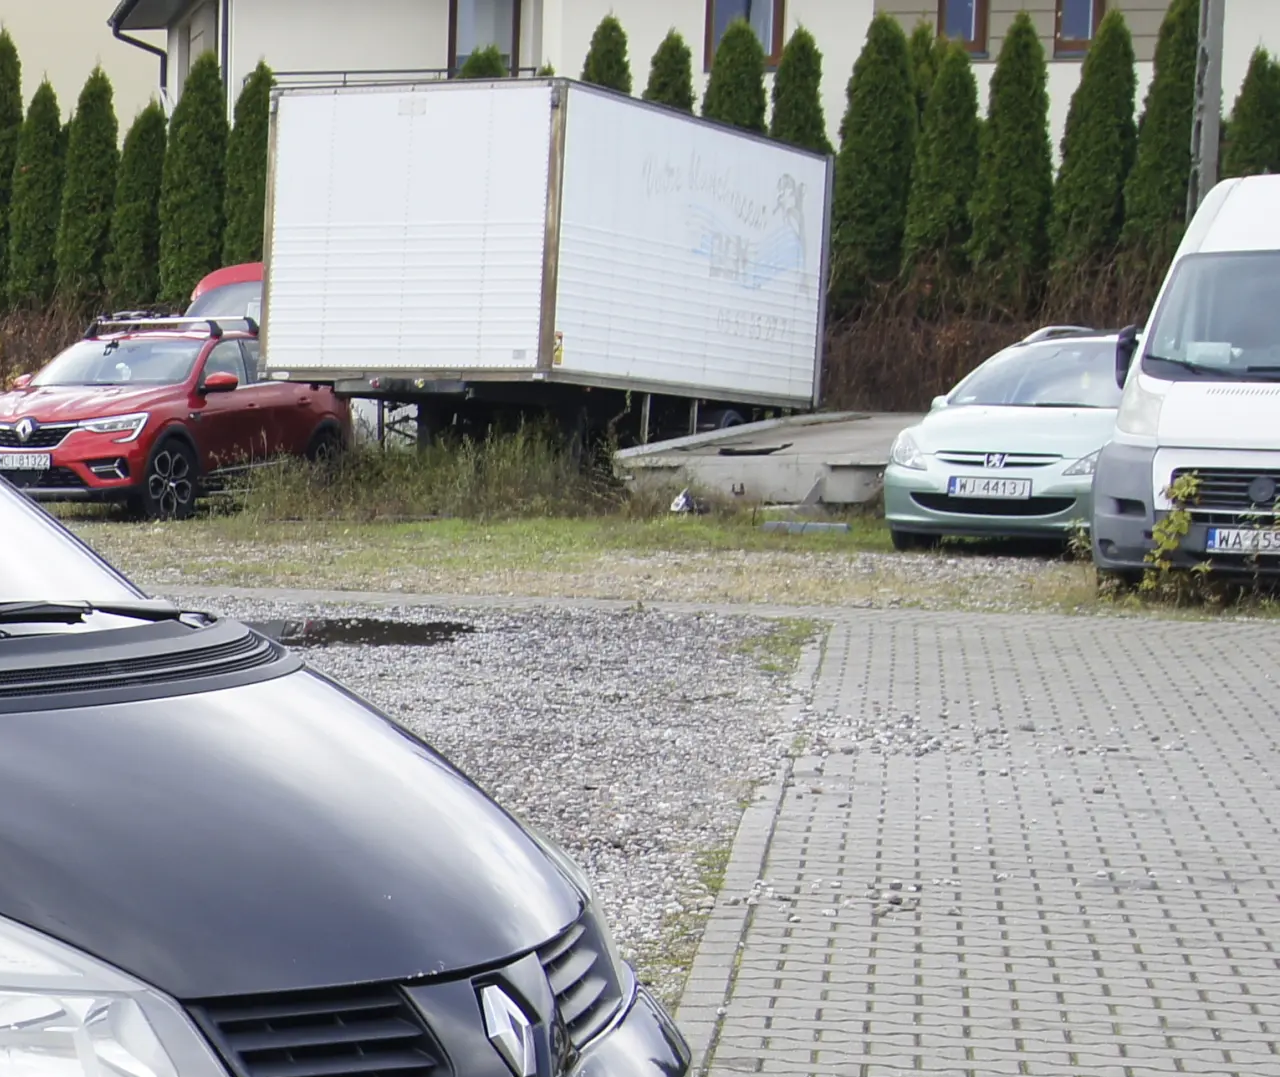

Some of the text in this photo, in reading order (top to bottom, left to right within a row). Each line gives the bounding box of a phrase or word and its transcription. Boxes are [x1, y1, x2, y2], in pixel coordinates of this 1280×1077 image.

[18, 454, 49, 467] 81322
[959, 478, 976, 493] WJ
[982, 479, 1026, 496] 4413J
[1219, 530, 1242, 548] WA
